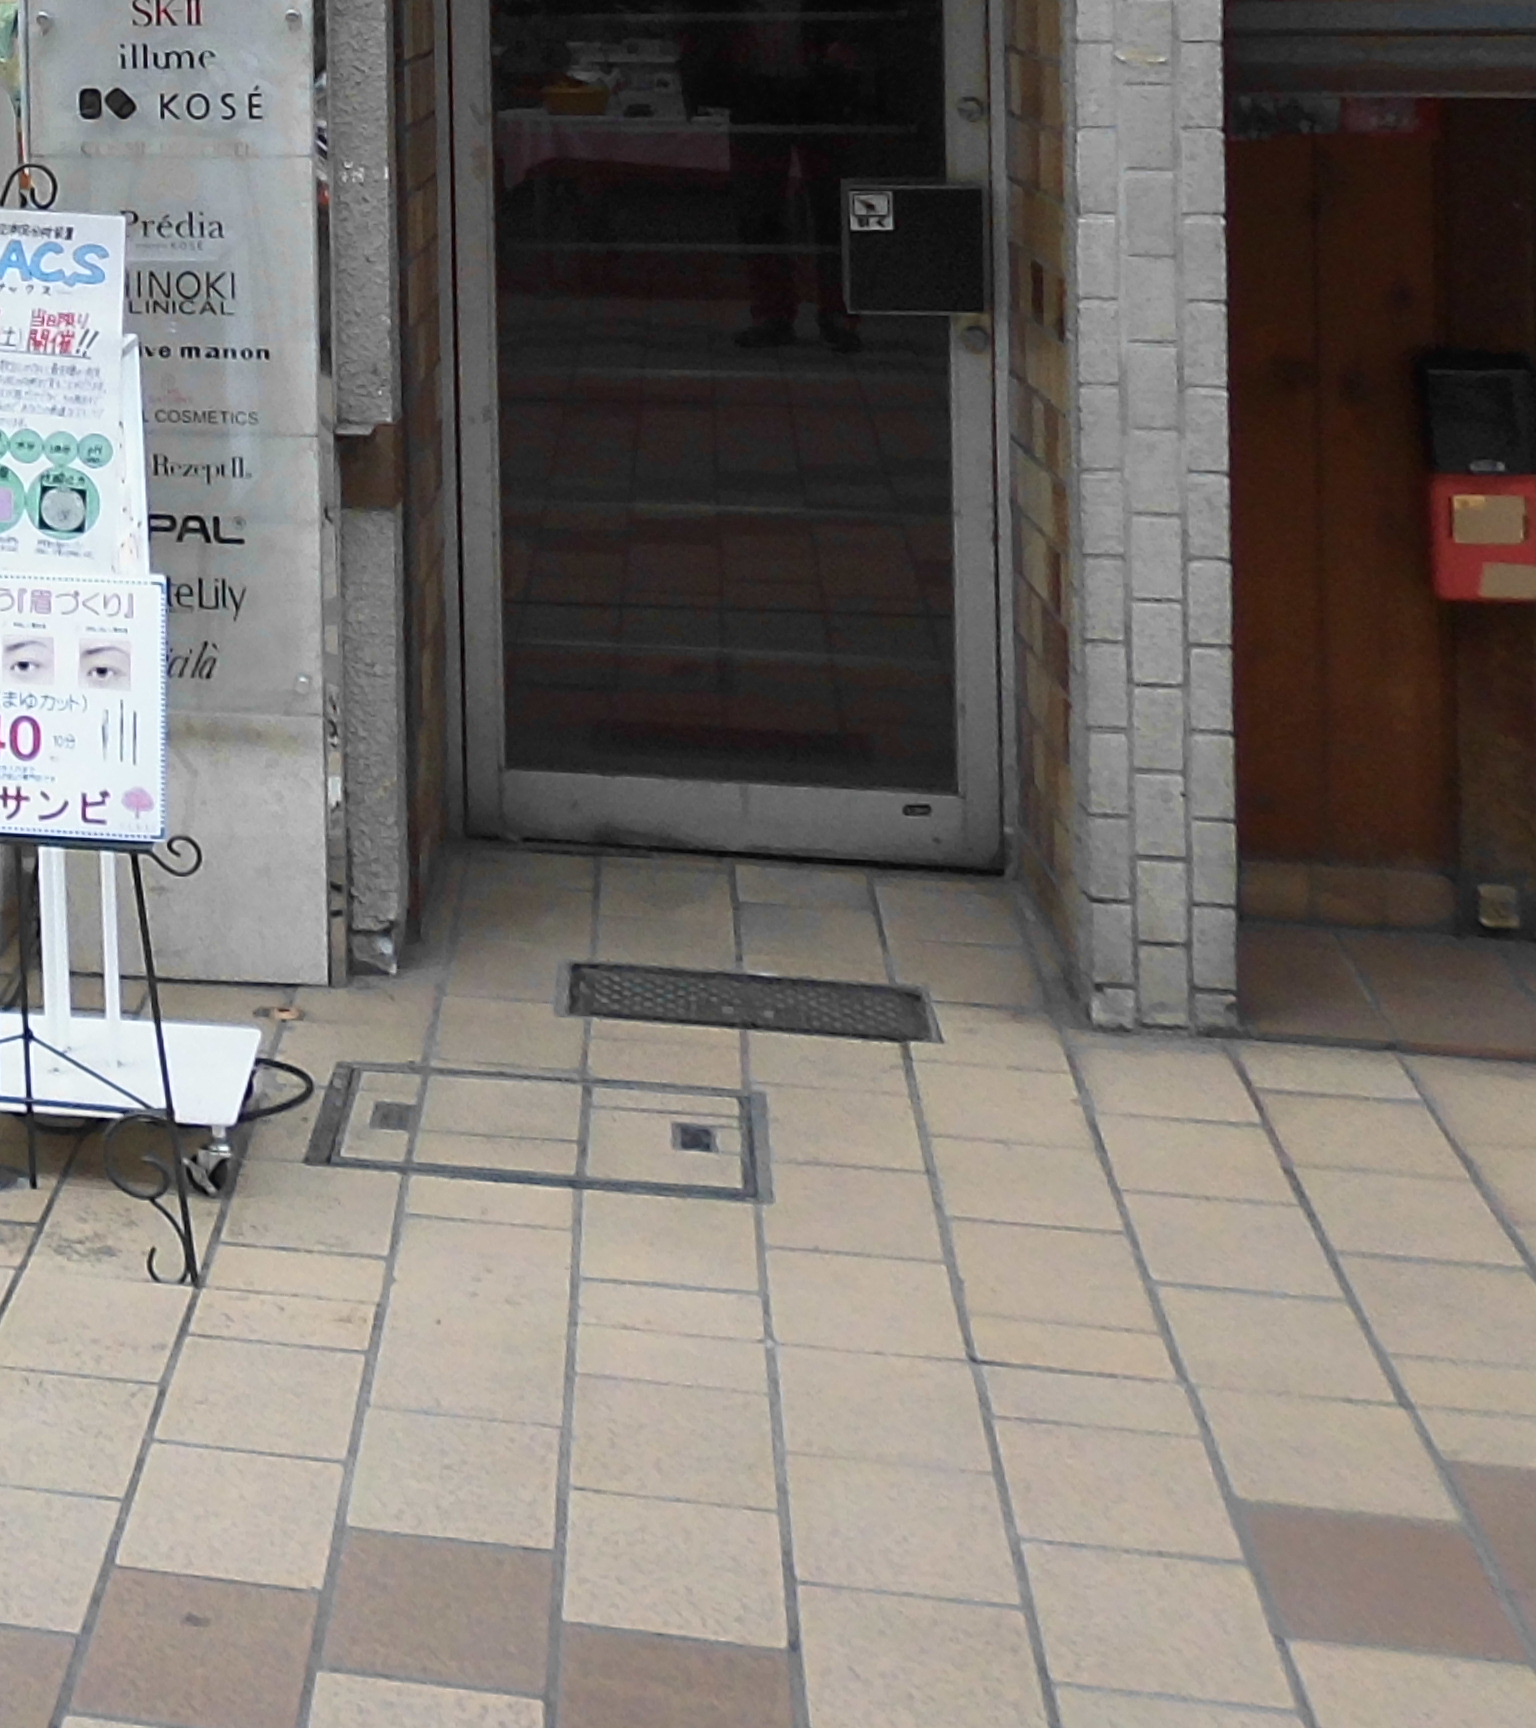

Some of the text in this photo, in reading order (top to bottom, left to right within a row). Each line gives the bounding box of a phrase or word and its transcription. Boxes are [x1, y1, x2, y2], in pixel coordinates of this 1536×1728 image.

[119, 43, 217, 70] illume
[159, 85, 264, 121] KOSÉ
[120, 209, 225, 240] Prédia
[126, 269, 237, 303] INOKI
[127, 298, 236, 316] LINICAL
[179, 345, 271, 362] manon
[148, 514, 245, 545] PAL
